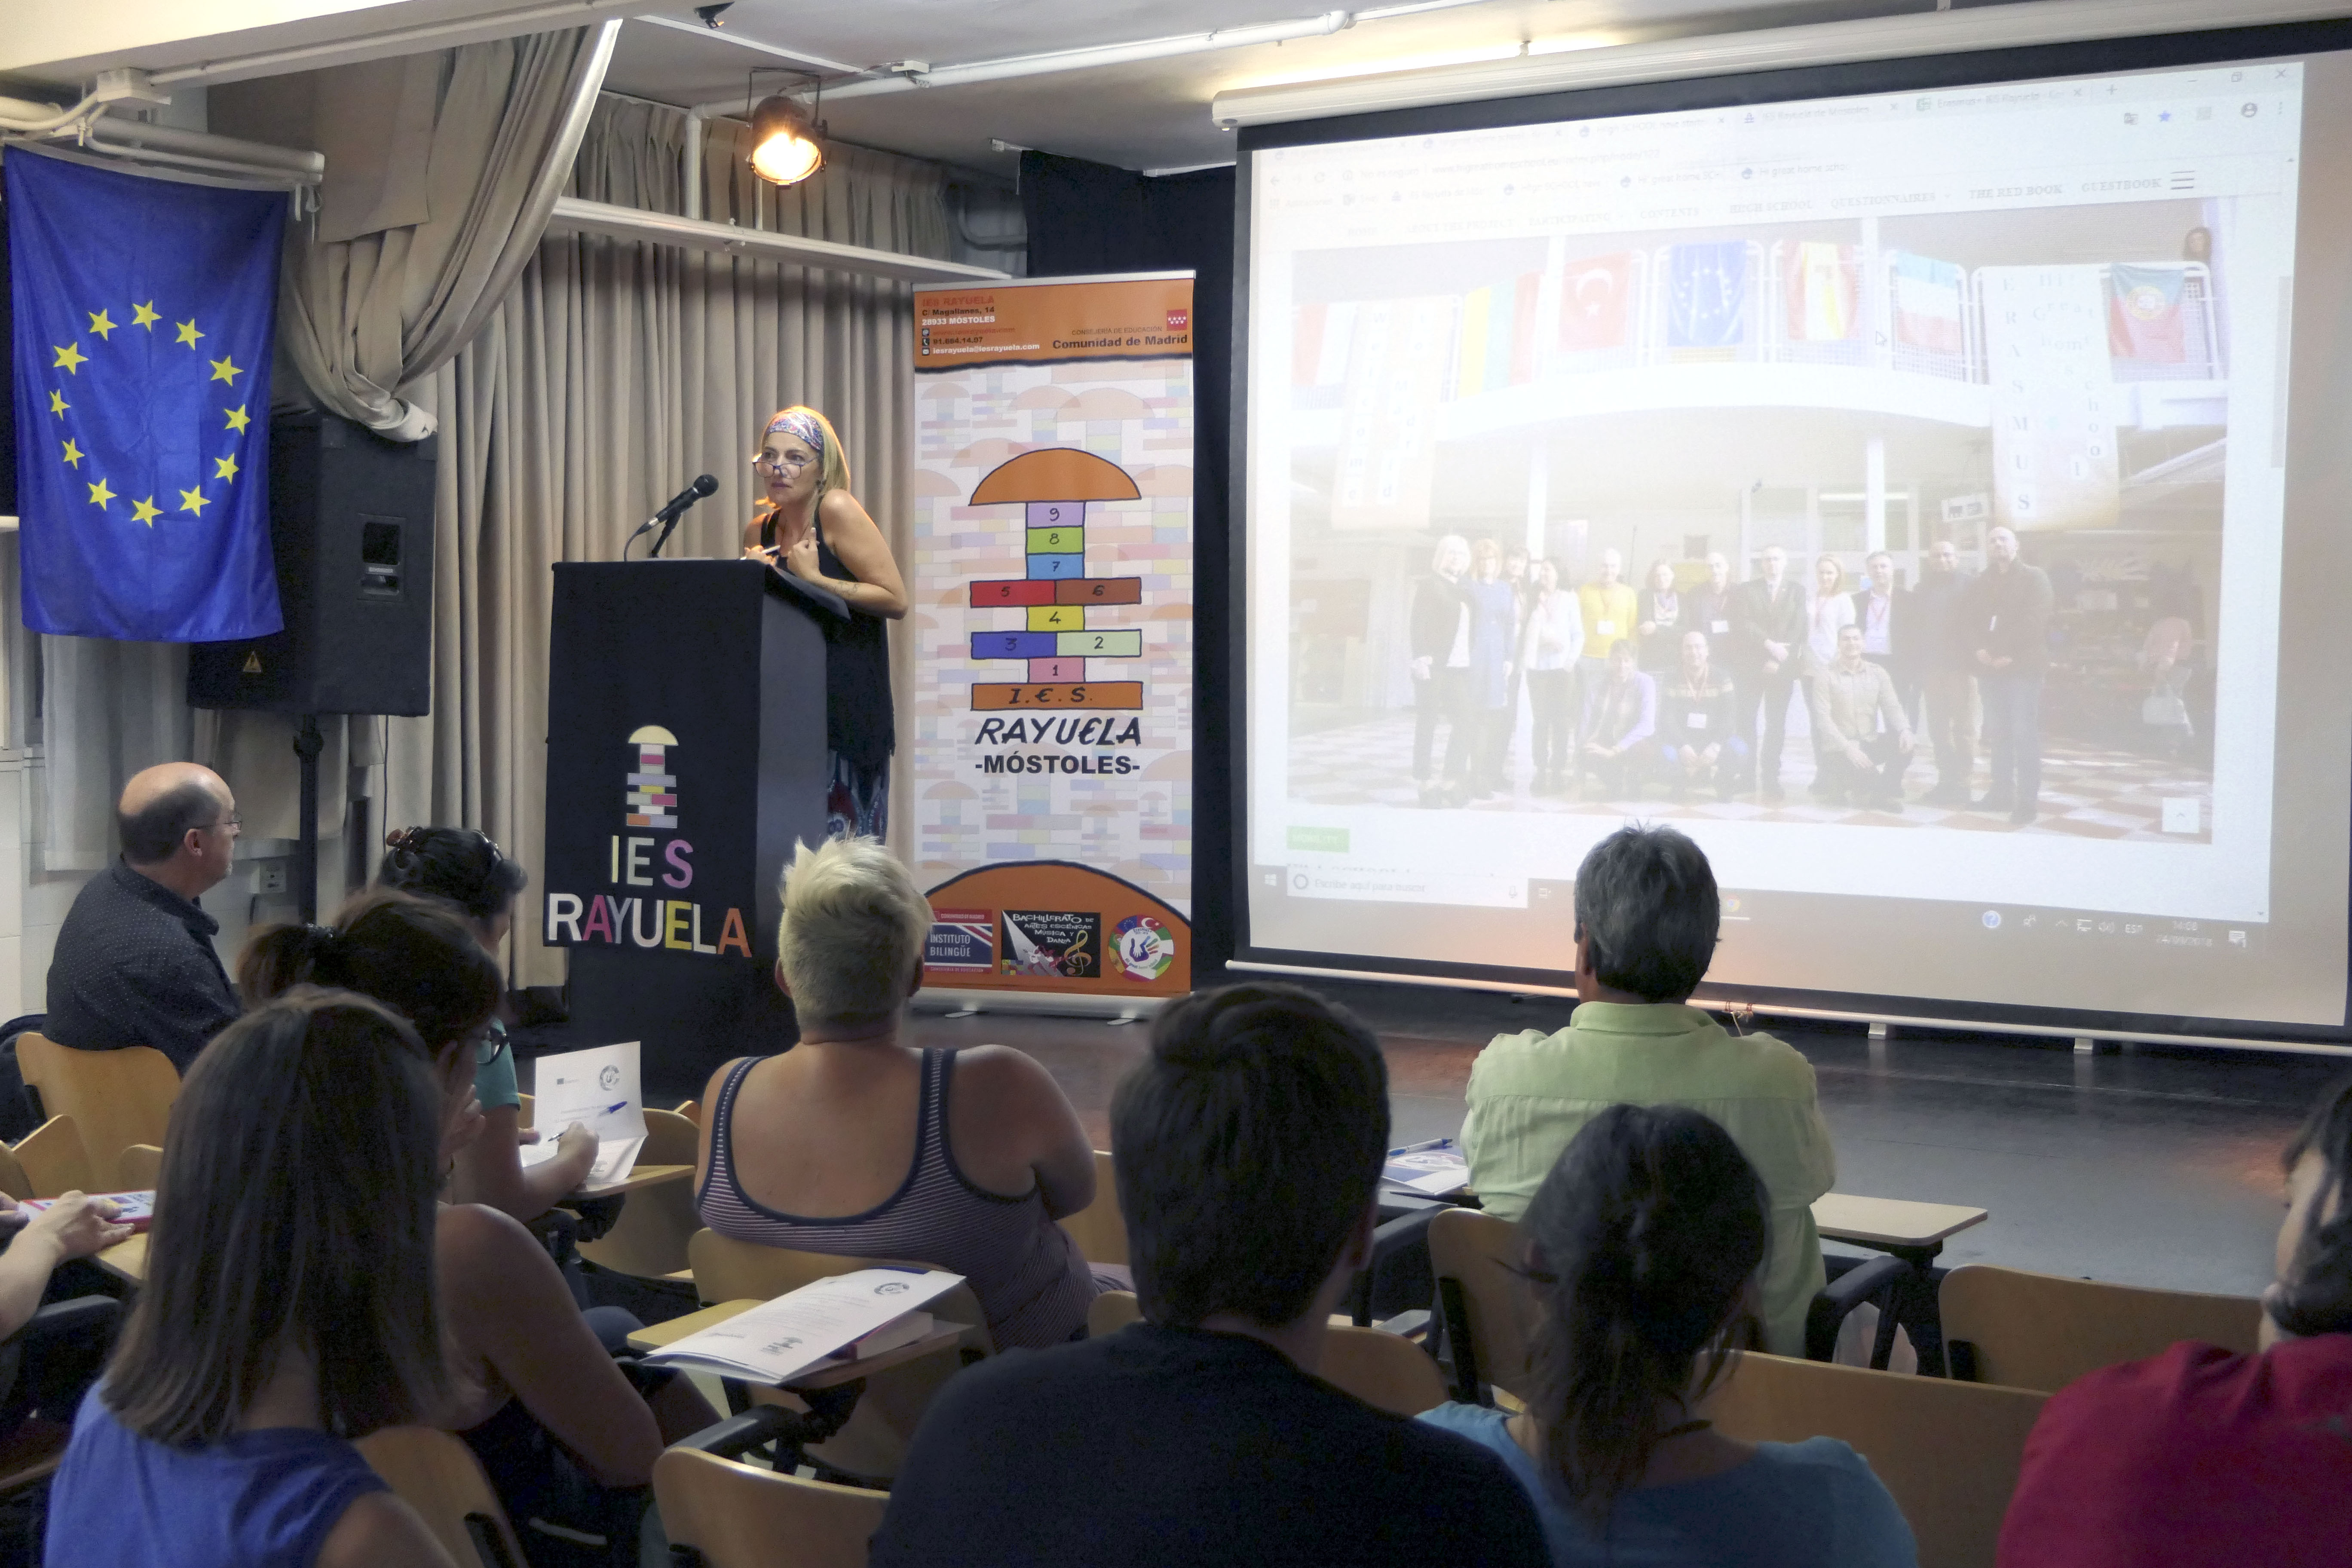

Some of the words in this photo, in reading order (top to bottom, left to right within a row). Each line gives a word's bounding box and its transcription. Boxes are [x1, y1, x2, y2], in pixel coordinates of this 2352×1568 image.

[1772, 166, 1795, 177] great
[1798, 163, 1822, 173] home
[1652, 174, 1673, 185] great
[1676, 173, 1700, 181] home
[2081, 177, 2162, 193] GUESTBOOK
[1969, 188, 1994, 199] THE
[1997, 187, 2023, 198] RED
[2026, 184, 2063, 196] BOOK
[1766, 200, 1813, 211] SCHOOL
[1831, 192, 1936, 209] QUESTIONNAIRES
[1529, 213, 1611, 226] PARTICIPATING
[1640, 207, 1700, 219] CONTENTS
[1467, 219, 1514, 230] PROJECT
[922, 318, 946, 326] 28933
[949, 315, 995, 325] MÓSTOLES
[1124, 325, 1162, 334] EDUCACIÓN
[1053, 337, 1122, 349] Comunidad
[1126, 336, 1141, 346] de
[1145, 334, 1188, 345] Madrid
[933, 343, 1040, 355] iesrayuela@iesrayuela.com
[1049, 508, 1060, 521] 9
[1049, 533, 1060, 544] 8
[1052, 561, 1060, 572] 7
[1001, 586, 1011, 597] 5
[1092, 585, 1105, 596] 6
[1049, 611, 1061, 624] 4
[1004, 638, 1017, 651] 3
[1095, 637, 1104, 649] 2
[1052, 665, 1059, 676] 1
[974, 716, 1141, 747] RAYUELA
[975, 750, 1140, 775] -MÓSTOLES-
[611, 835, 694, 889] IES
[1315, 878, 1347, 888] Escribe
[1351, 880, 1370, 891] aquí
[1372, 882, 1393, 892] para
[1396, 882, 1426, 892] buscar
[548, 893, 752, 958] RAYUELA
[930, 934, 971, 944] INSTITUTO
[930, 945, 971, 957] BILINGÜE
